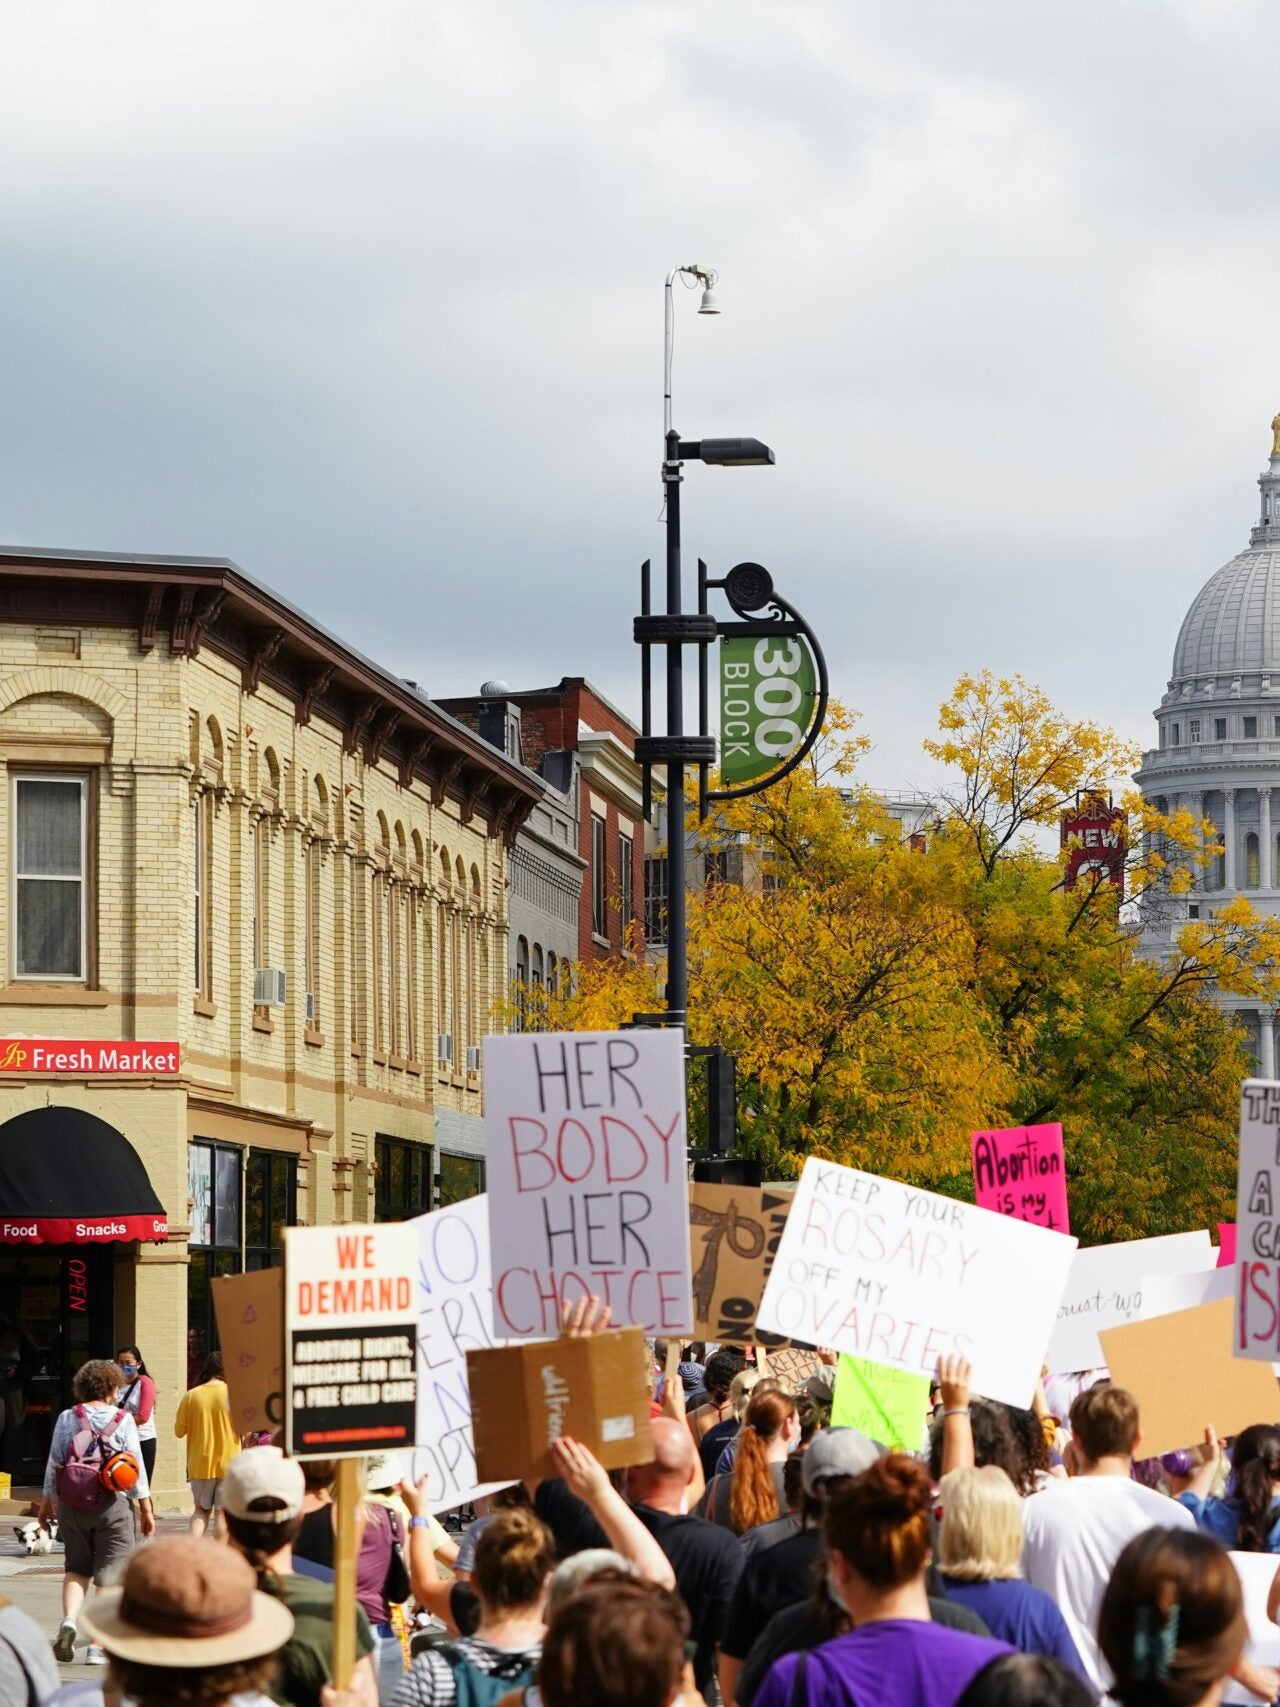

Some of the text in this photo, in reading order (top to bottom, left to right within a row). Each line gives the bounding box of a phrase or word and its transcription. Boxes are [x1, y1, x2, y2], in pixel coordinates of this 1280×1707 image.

[724, 663, 750, 757] BLOCK
[754, 637, 802, 758] 300
[1067, 828, 1121, 849] NEW
[32, 1048, 93, 1070] Fresh
[98, 1049, 177, 1071] Market
[533, 1039, 643, 1113] HER
[509, 1111, 680, 1193] BODY
[975, 1132, 1060, 1192] Abortion
[814, 1167, 966, 1230] KEEP YOUR
[997, 1192, 1047, 1216] is my
[1248, 1170, 1273, 1216] A
[4, 1224, 38, 1237] Food
[75, 1222, 127, 1237] Snacks
[336, 1235, 375, 1269] WE
[541, 1190, 652, 1268] HER
[801, 1198, 981, 1287] ROSARY
[69, 1258, 88, 1312] OPEN
[297, 1277, 410, 1316] DEMAND
[496, 1267, 687, 1334] CHOICE
[788, 1258, 889, 1306] OFF MY
[1057, 1289, 1105, 1319] rust
[716, 1298, 755, 1341] NO
[775, 1287, 976, 1372] OVARIES
